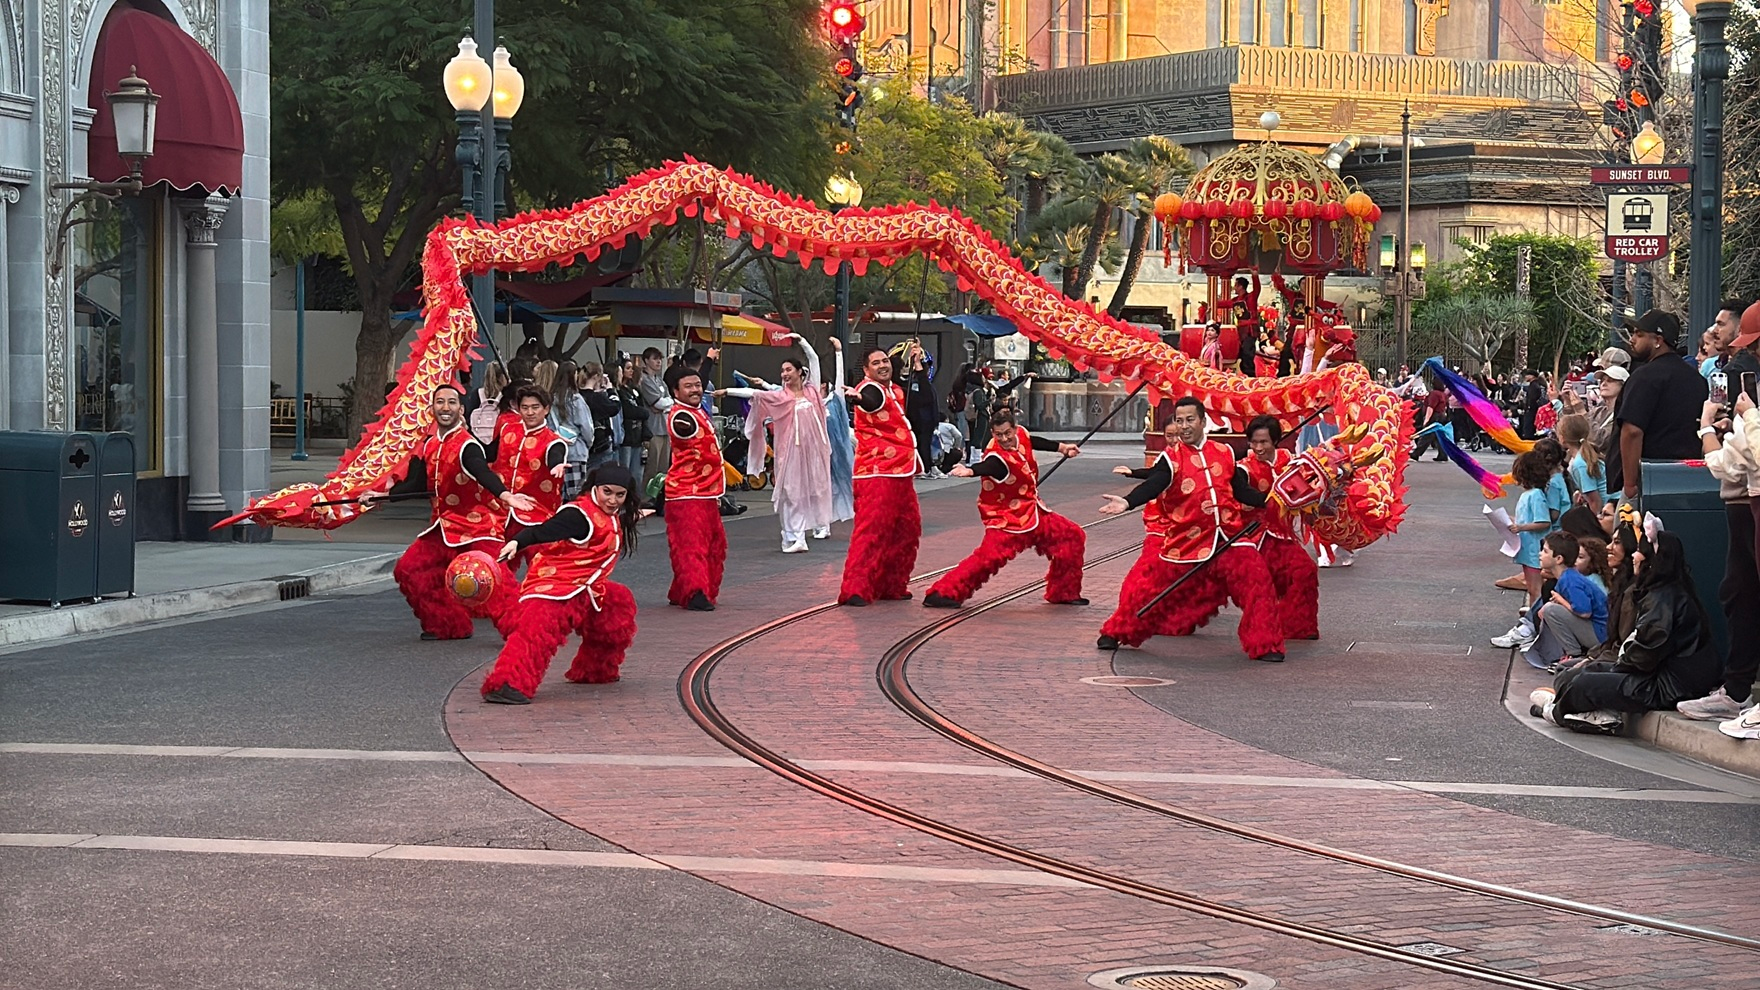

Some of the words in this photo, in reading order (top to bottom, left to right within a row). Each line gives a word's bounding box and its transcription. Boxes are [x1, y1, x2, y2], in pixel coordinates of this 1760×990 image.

[1609, 170, 1642, 180] SUNSET
[1647, 170, 1672, 180] BLVD.
[1615, 238, 1636, 247] RED
[1638, 238, 1659, 247] CAR
[1614, 247, 1660, 256] TROLLEY
